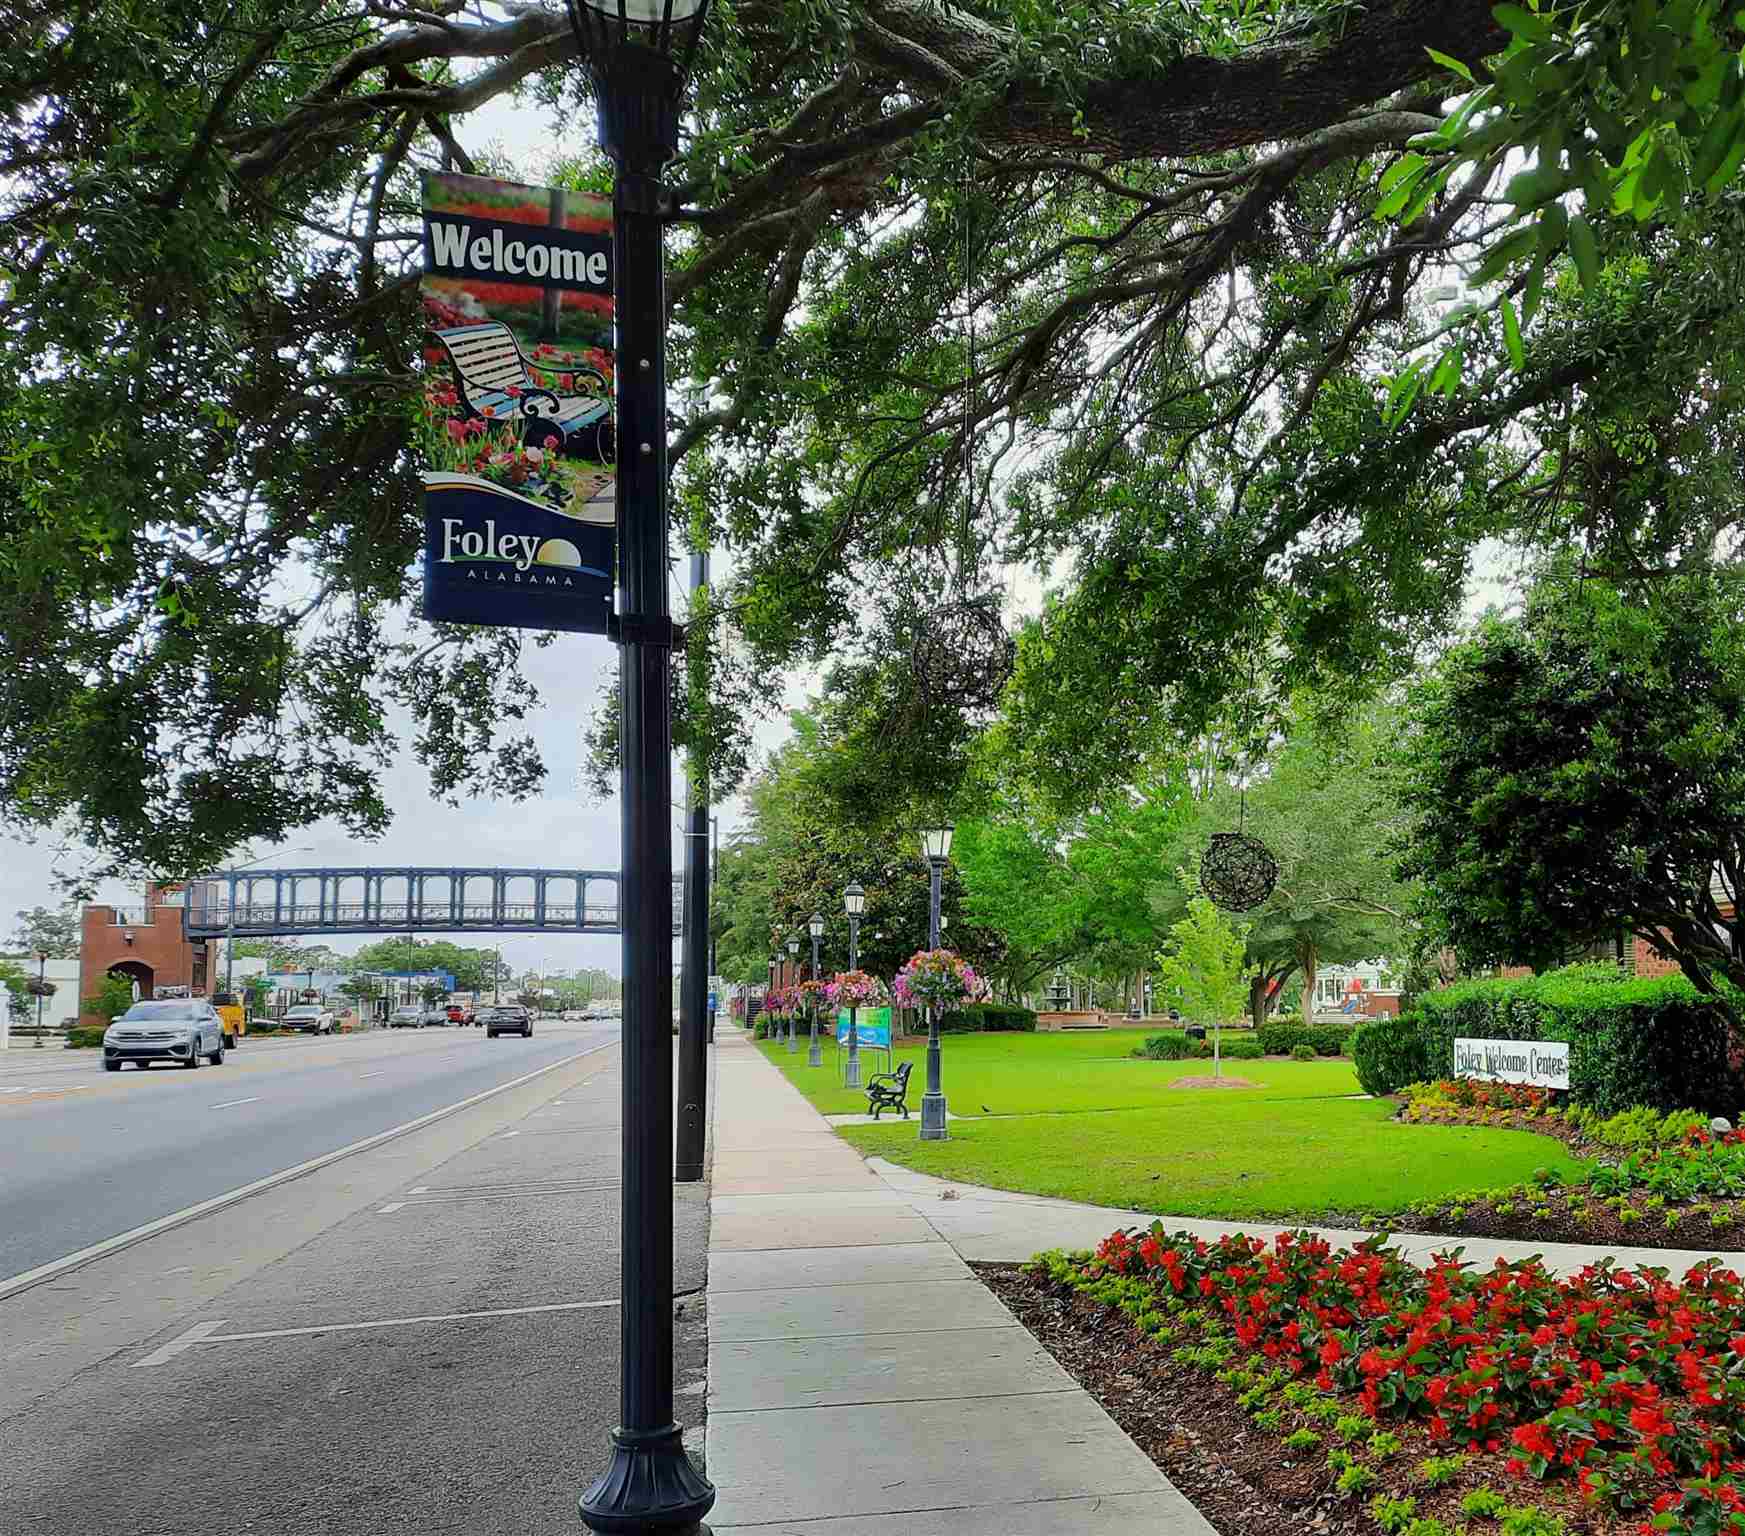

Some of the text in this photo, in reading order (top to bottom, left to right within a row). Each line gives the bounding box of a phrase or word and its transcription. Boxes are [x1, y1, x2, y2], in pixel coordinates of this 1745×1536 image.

[430, 222, 608, 285] Welcome
[441, 518, 541, 571] Foley
[466, 569, 573, 586] ALABAMA
[1456, 1043, 1482, 1073] Foley
[1485, 1045, 1528, 1074] Welcome
